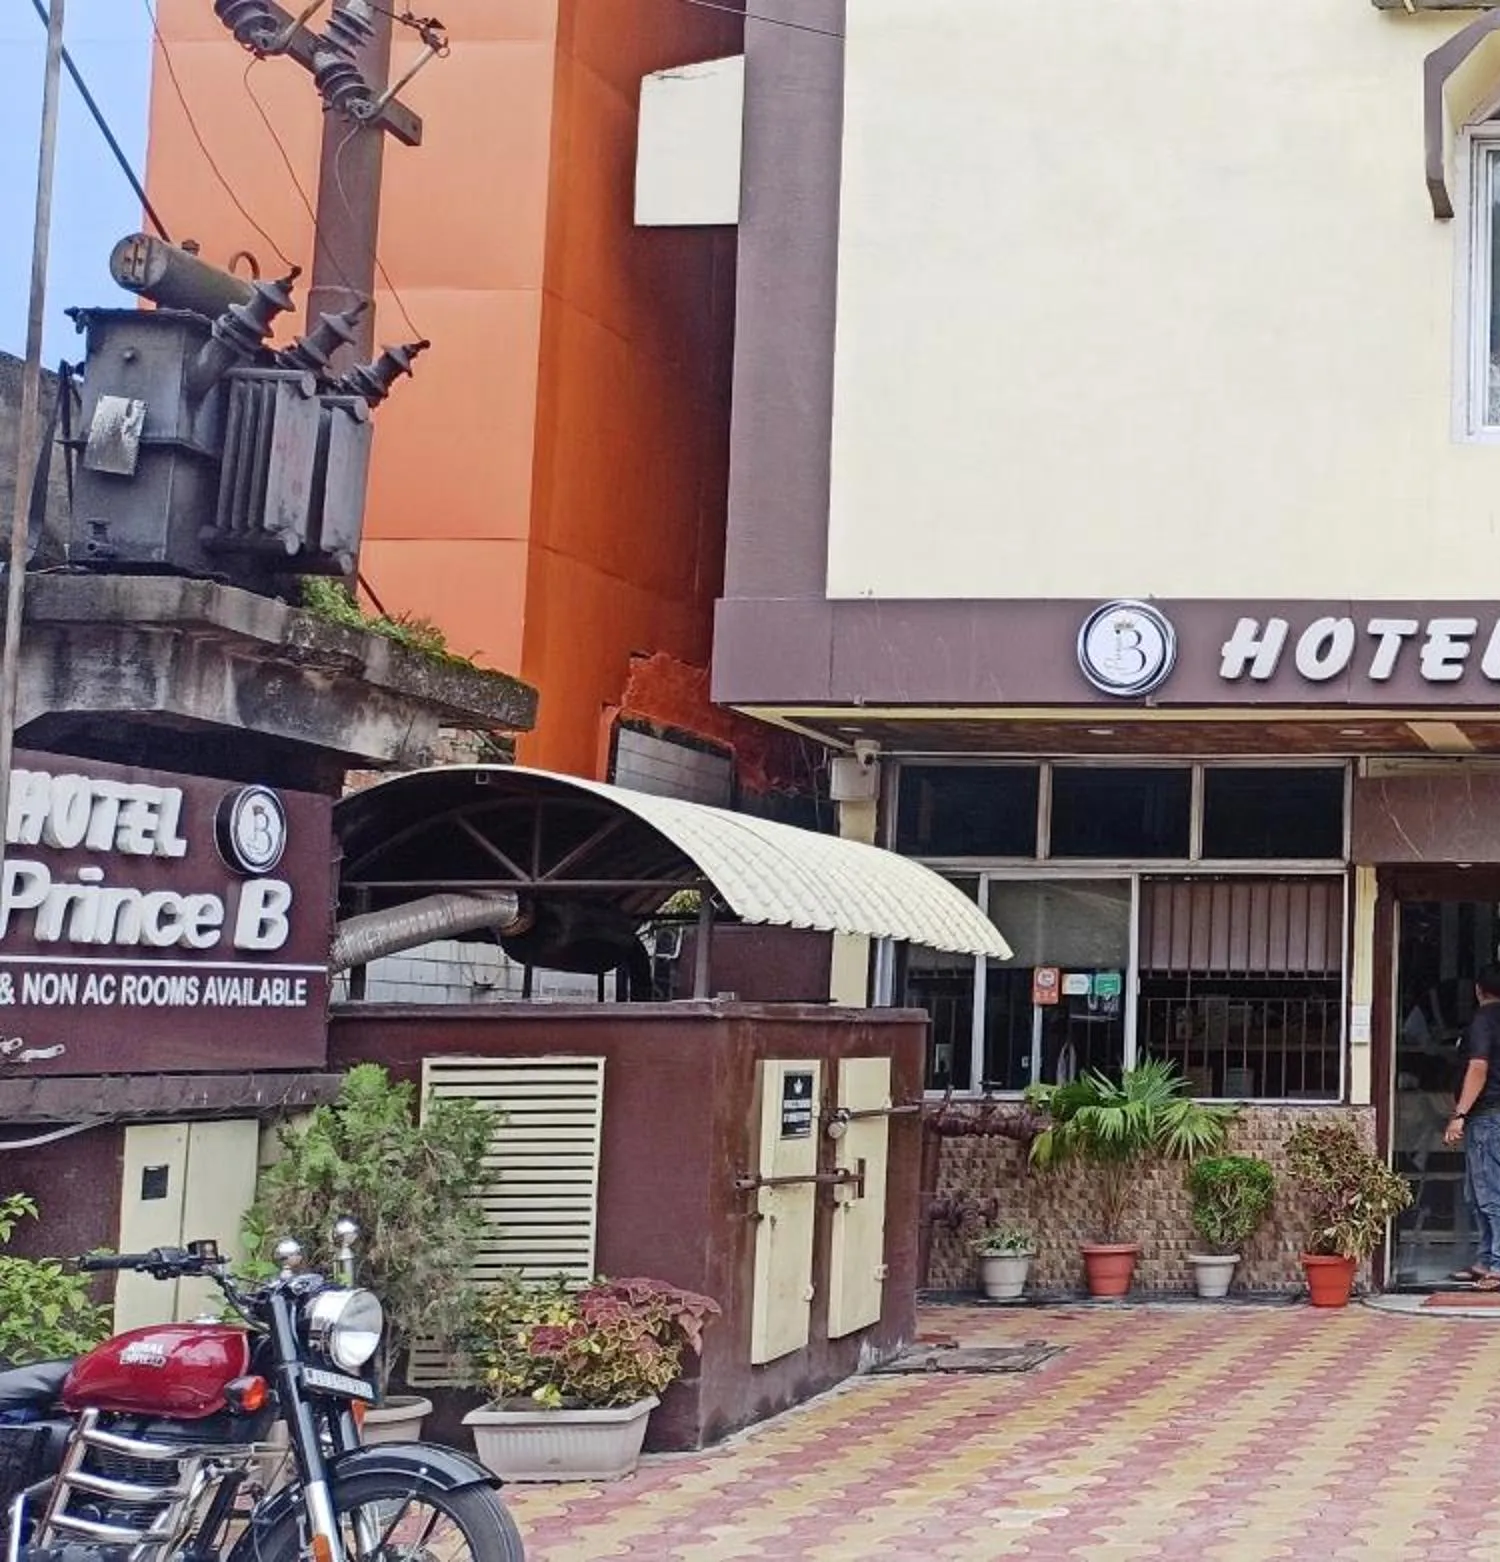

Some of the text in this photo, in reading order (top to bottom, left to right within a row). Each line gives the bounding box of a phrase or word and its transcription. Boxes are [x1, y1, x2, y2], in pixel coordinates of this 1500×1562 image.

[5, 769, 188, 857] HOTEL
[0, 859, 292, 950] Prince B
[0, 972, 308, 1007] & NON AC ROOMS AVAILABLE
